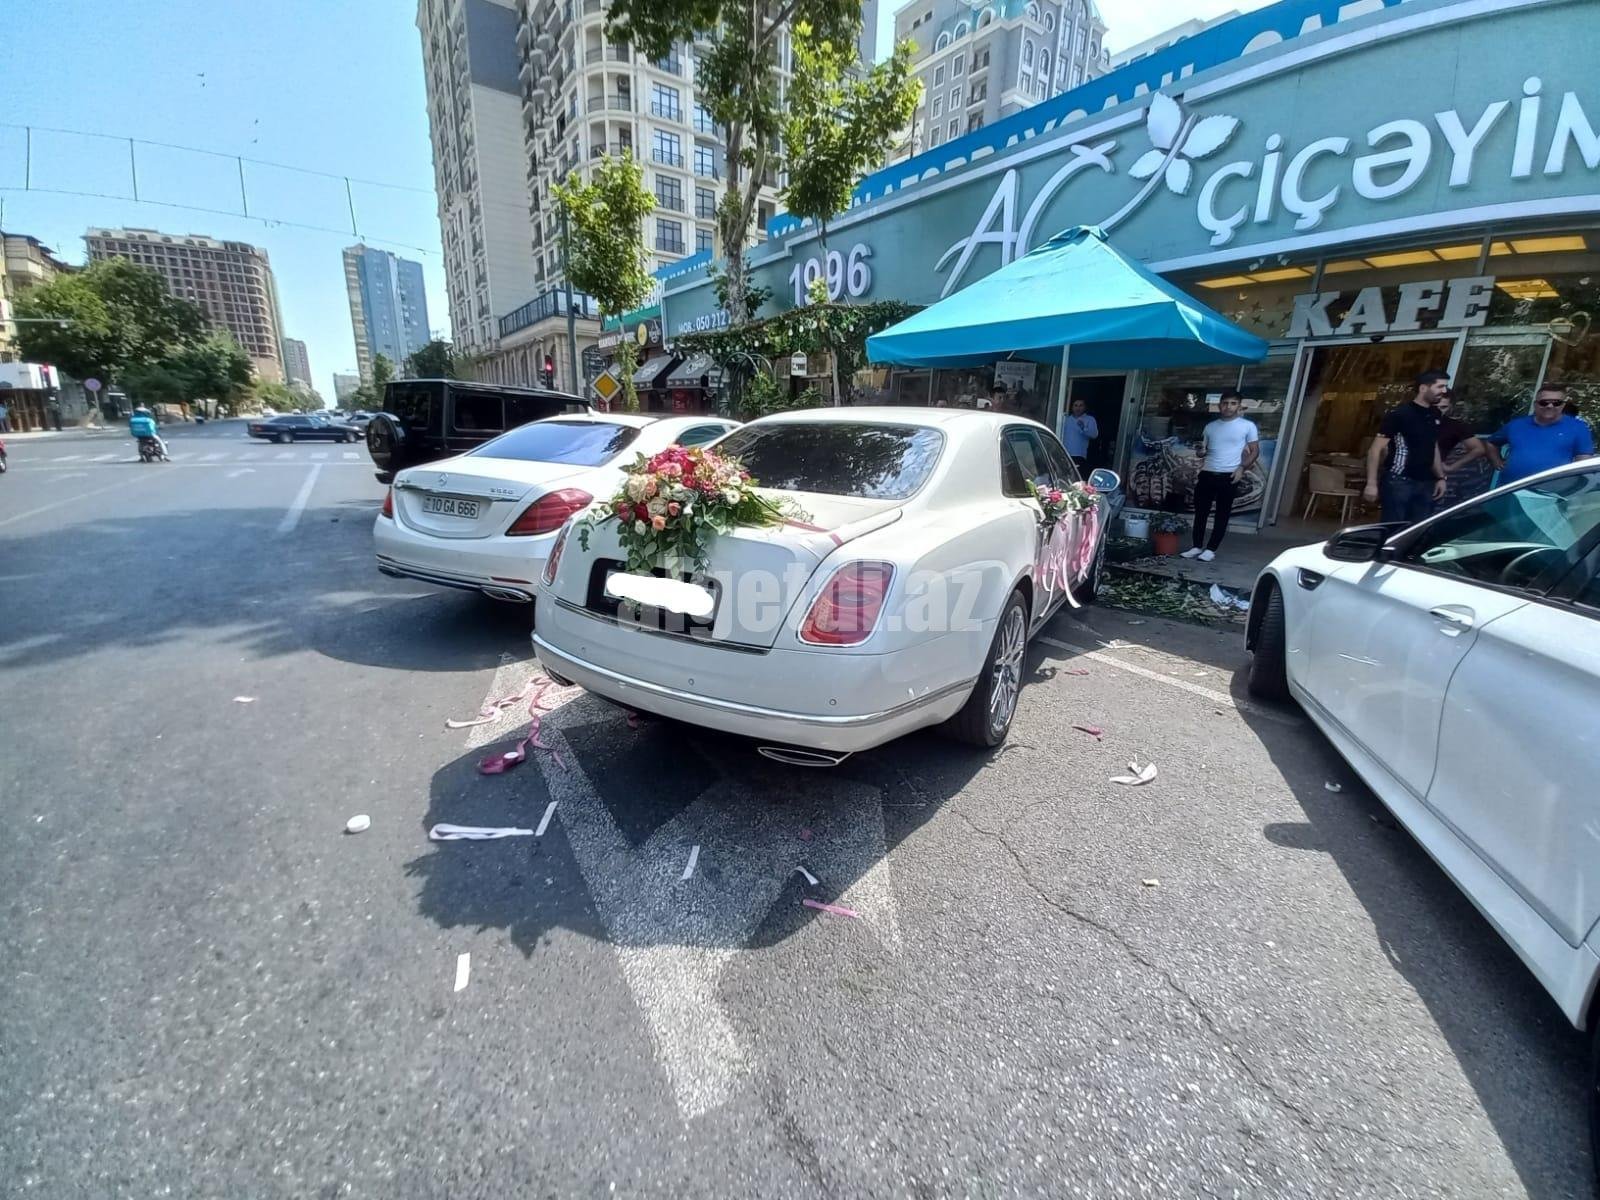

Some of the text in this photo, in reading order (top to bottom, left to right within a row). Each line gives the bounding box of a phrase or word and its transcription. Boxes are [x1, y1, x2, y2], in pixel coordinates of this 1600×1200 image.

[788, 243, 872, 307] 1996
[696, 314, 710, 331] 050
[1286, 275, 1496, 338] KAFE
[431, 496, 477, 516] 10 GA 666
